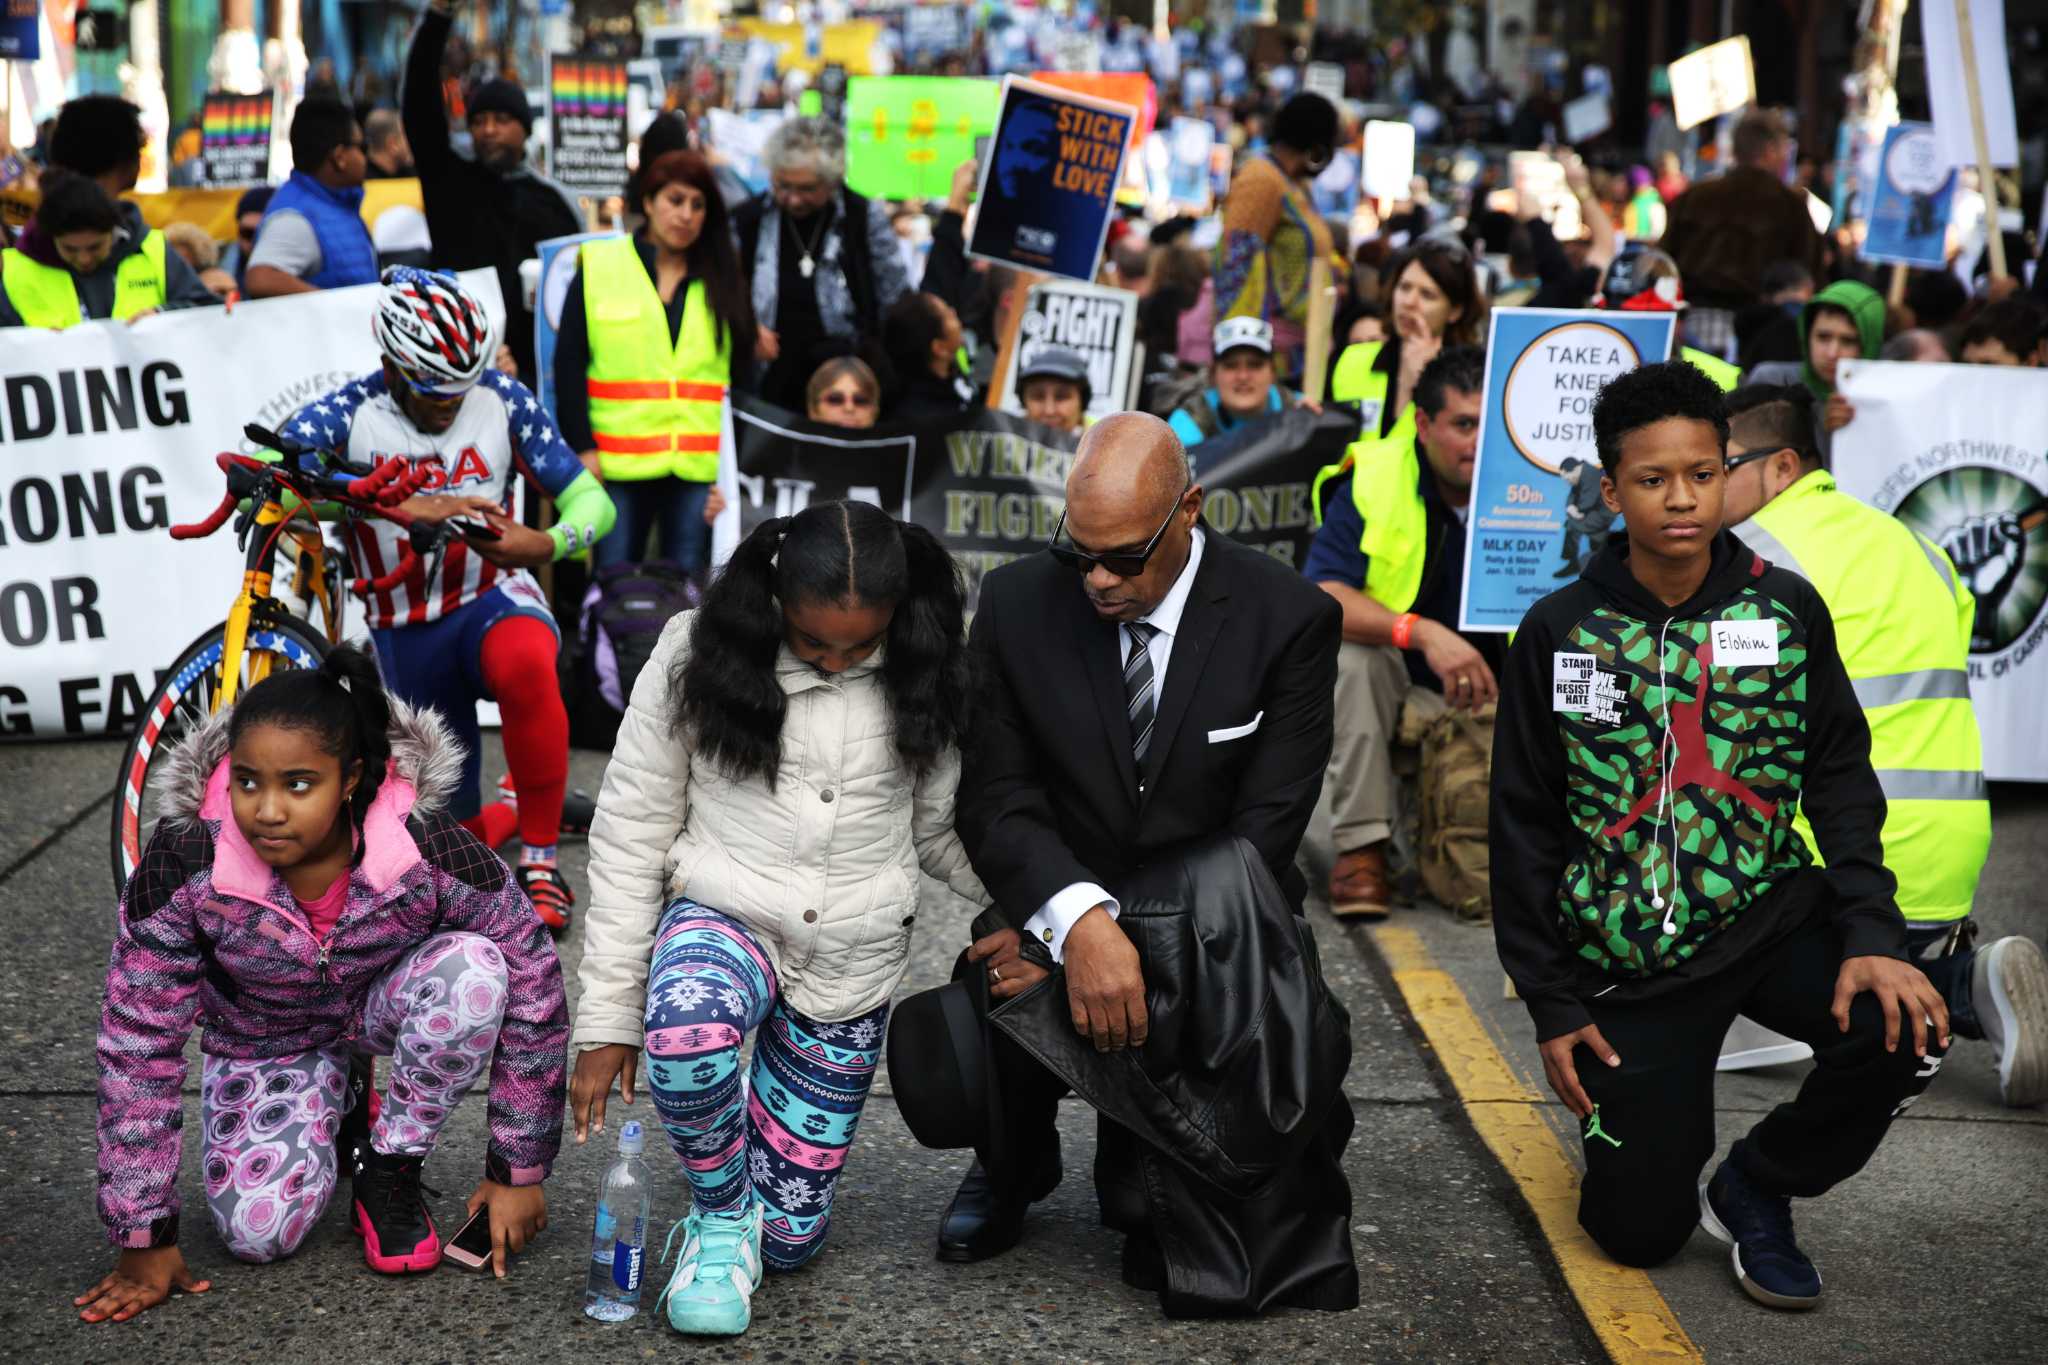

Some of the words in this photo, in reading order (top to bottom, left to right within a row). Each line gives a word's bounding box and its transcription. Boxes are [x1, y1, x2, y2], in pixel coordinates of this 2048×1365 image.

[1055, 104, 1125, 143] STICK
[1060, 133, 1120, 171] WITH
[1041, 294, 1123, 351] FIGHT
[1546, 346, 1601, 365] TAKE
[1607, 348, 1620, 365] A
[0, 361, 192, 444] DING
[1532, 422, 1597, 441] JUSTI
[1916, 438, 2043, 474] NORTHWEST
[1507, 484, 1545, 503] 50th
[0, 463, 170, 547] ONG
[1483, 538, 1514, 552] MLK
[1517, 539, 1547, 553] DAY
[1562, 658, 1594, 669] STAND
[1580, 669, 1594, 679] UP
[1596, 671, 1616, 689] WE
[1556, 683, 1590, 695] RESIST
[59, 667, 172, 736] FA
[1565, 694, 1589, 705] HATE
[1590, 707, 1622, 724] BACK
[627, 1247, 642, 1290] smart
